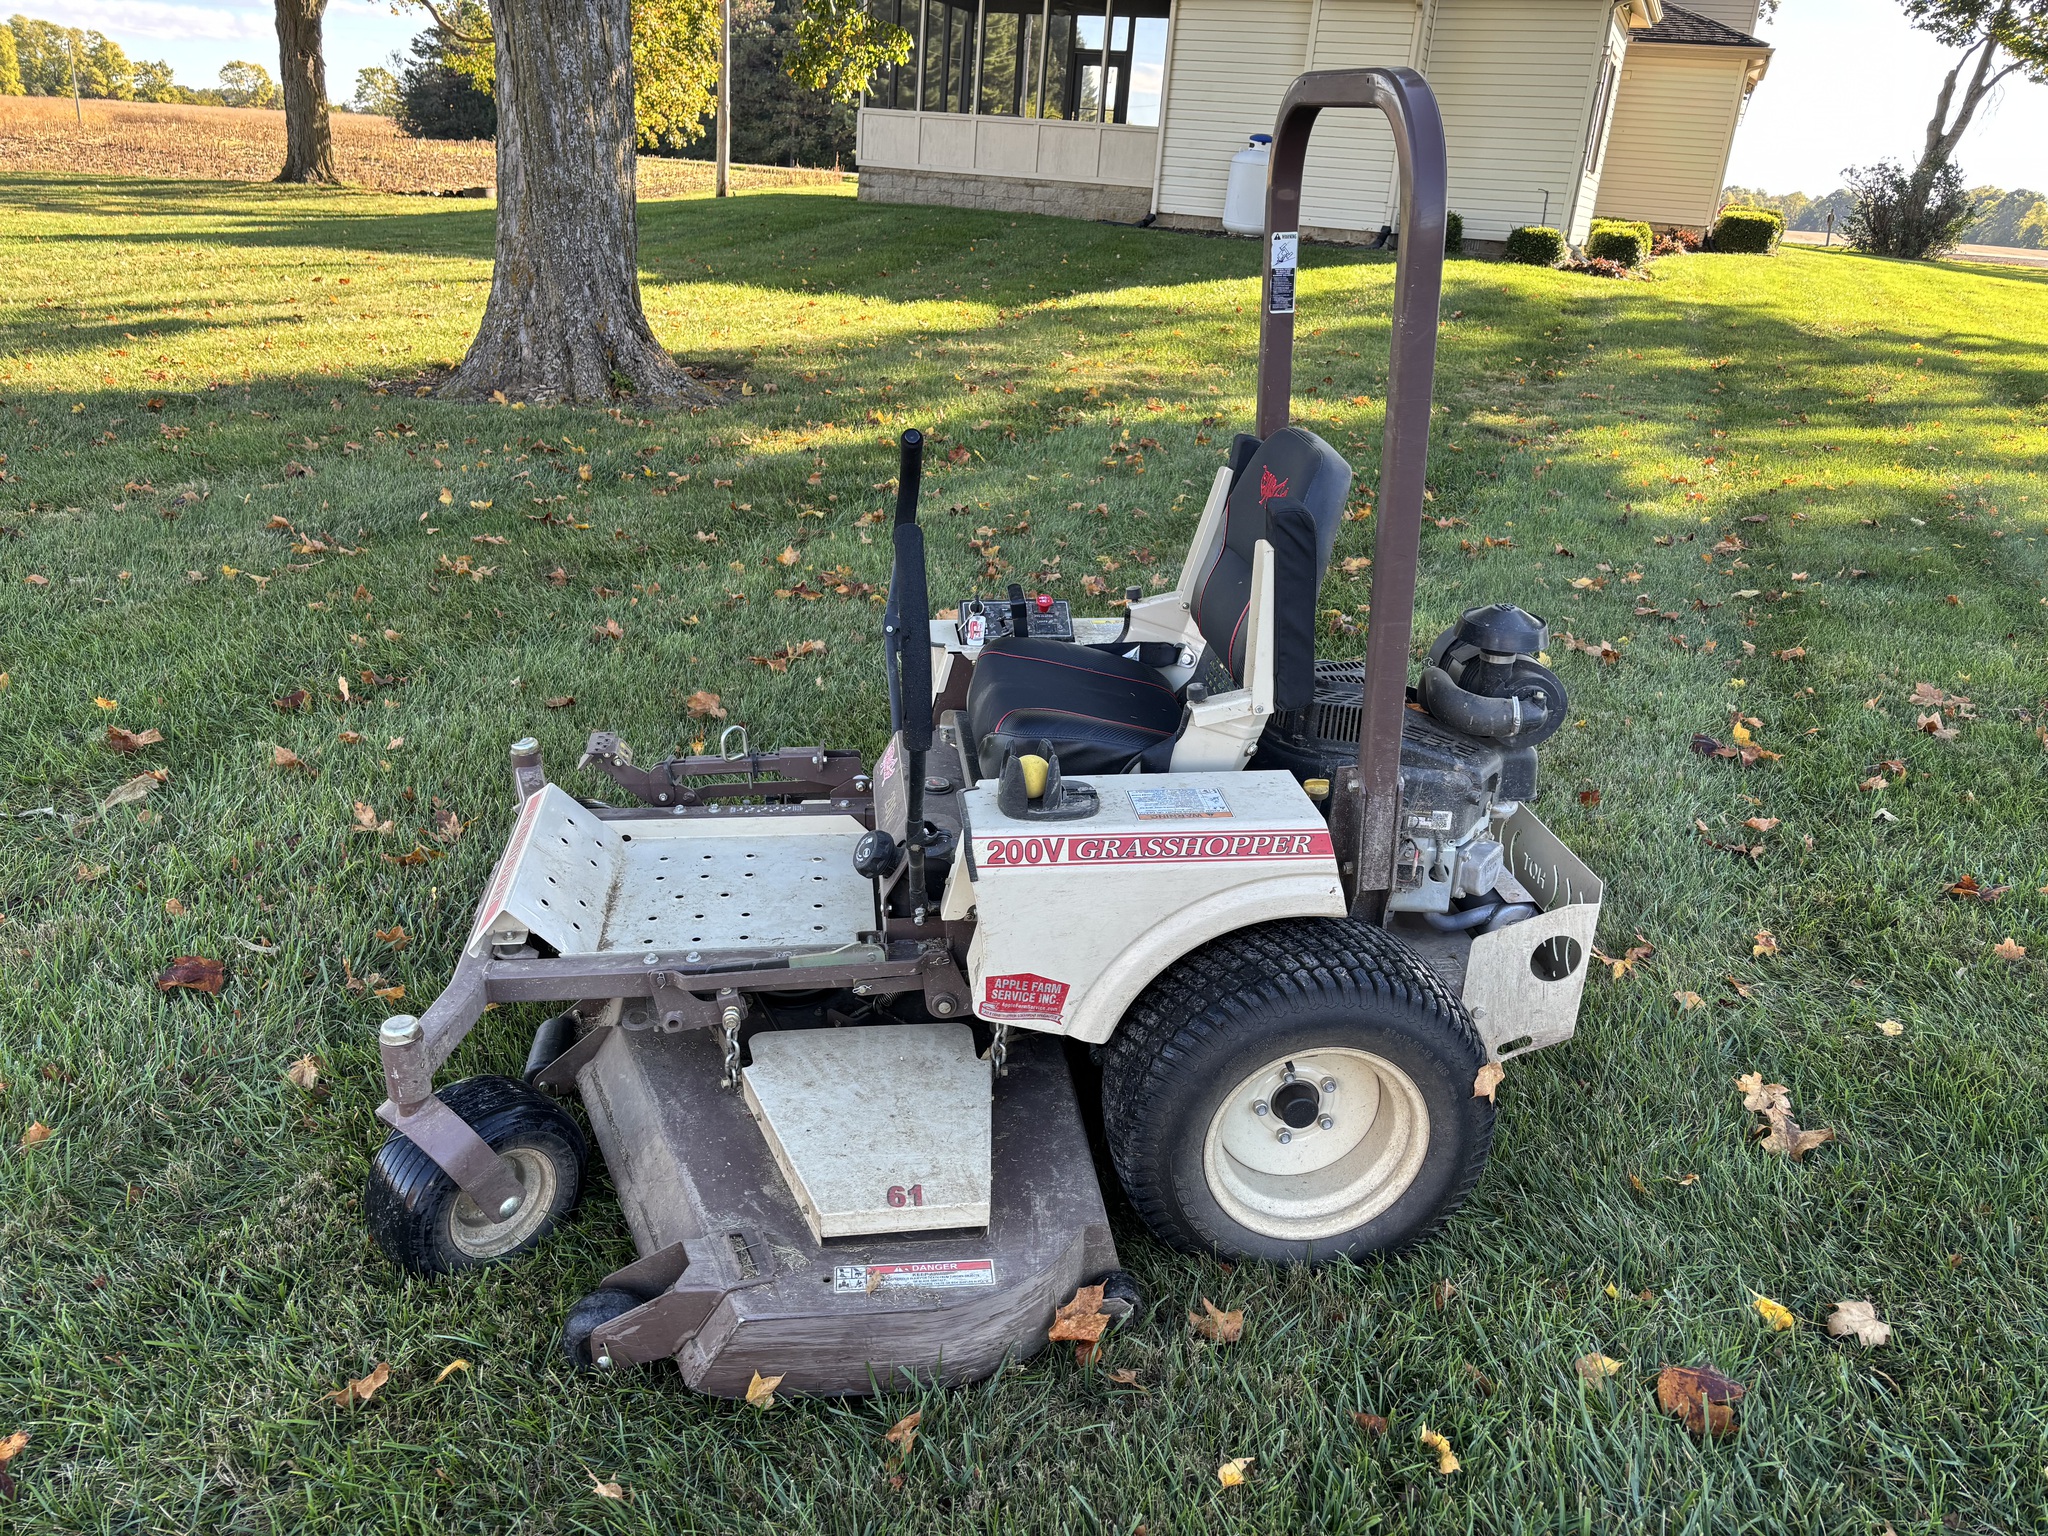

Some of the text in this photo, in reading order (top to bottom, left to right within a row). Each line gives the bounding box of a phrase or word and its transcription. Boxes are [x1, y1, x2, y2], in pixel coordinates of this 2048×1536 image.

[986, 835, 1313, 865] 200V GRASSHOPPER
[994, 978, 1062, 994] APPLE FARM
[991, 989, 1060, 1005] SERVICE INC.
[886, 1183, 923, 1208] 61
[911, 1263, 958, 1272] DANGER
